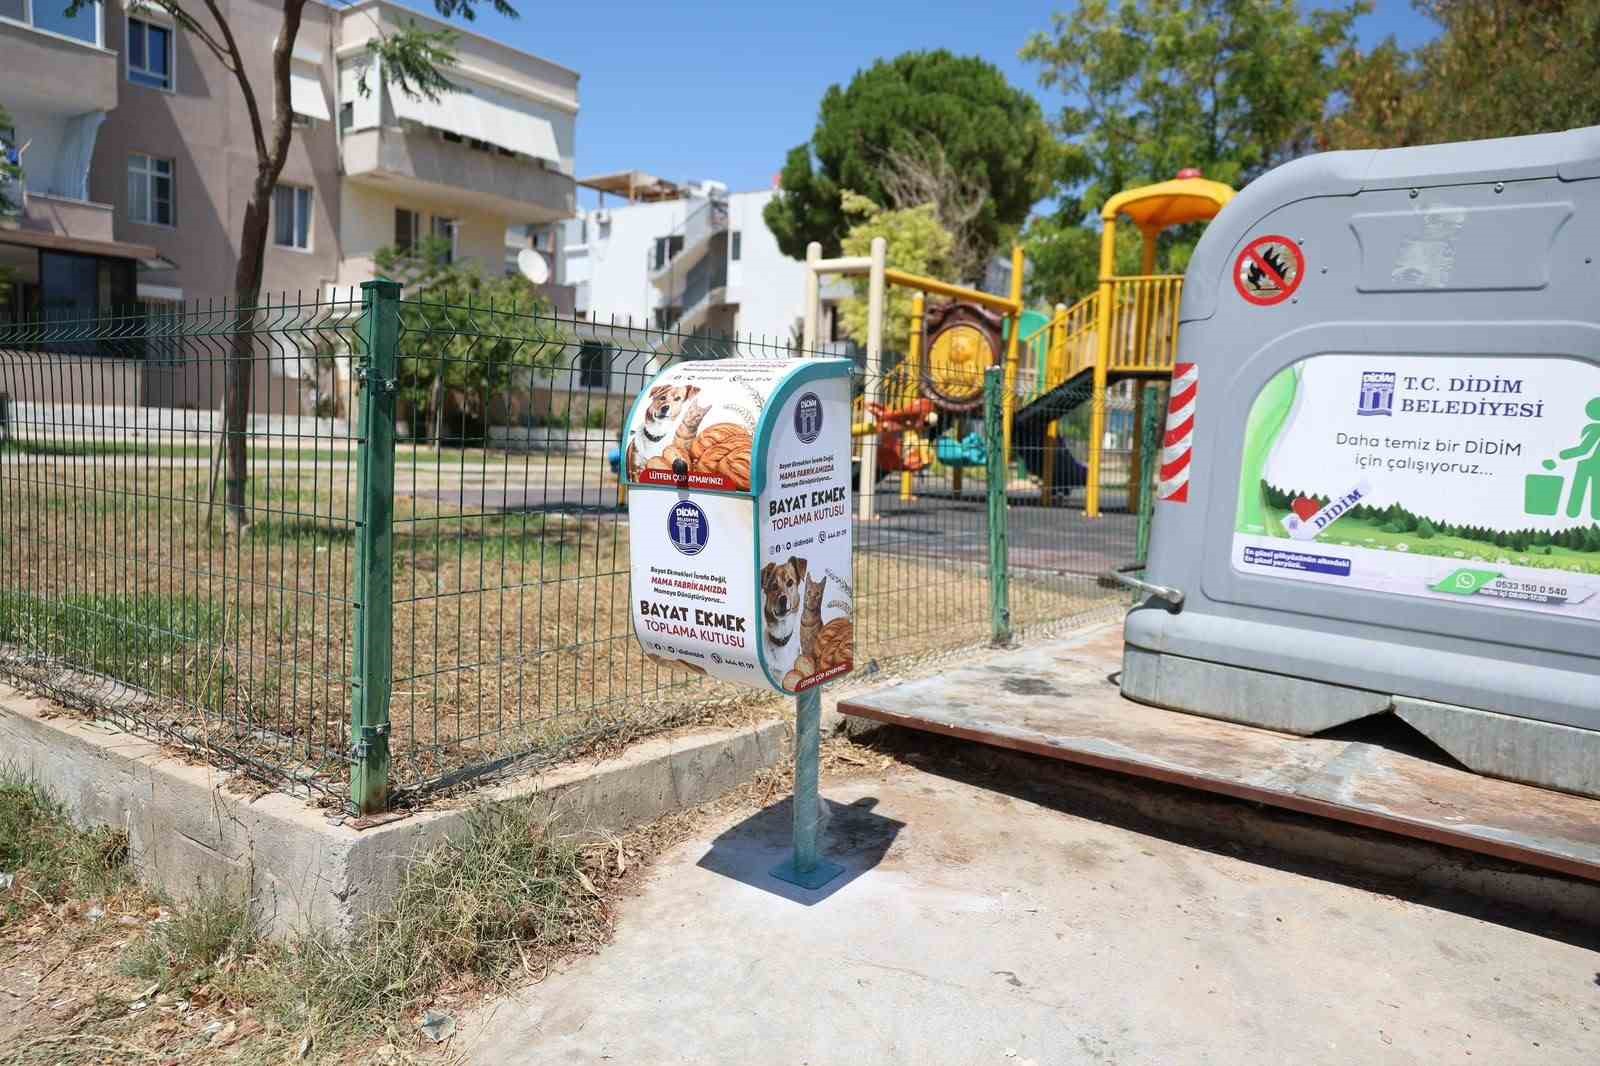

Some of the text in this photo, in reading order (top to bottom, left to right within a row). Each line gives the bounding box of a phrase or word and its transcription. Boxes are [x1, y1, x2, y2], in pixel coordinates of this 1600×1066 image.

[1402, 374, 1524, 394] T.C. DİDİM
[1400, 397, 1545, 419] BELEDİYESİ
[1335, 432, 1522, 457] Daha temiz bir DİDİM
[649, 471, 672, 480] LÜTFEN
[779, 471, 797, 481] MAMA
[1355, 454, 1493, 477] için çalışıyoruz...
[769, 486, 846, 517] BAYAT EKMEK
[1313, 487, 1363, 530] DİDİM
[772, 504, 845, 532] TOPLAMA KUTUSU
[650, 566, 666, 575] Bayat
[667, 569, 693, 578] Ekmekleri
[651, 576, 727, 595] MAMA FABRİKAMIZDA
[654, 587, 677, 597] Mamaya
[1496, 580, 1519, 590] 0533
[1522, 583, 1537, 592] 150
[1548, 587, 1568, 596] 540
[640, 600, 746, 633] BAYAT EKMEK
[645, 619, 745, 648] TOPLAMA KUTUSU
